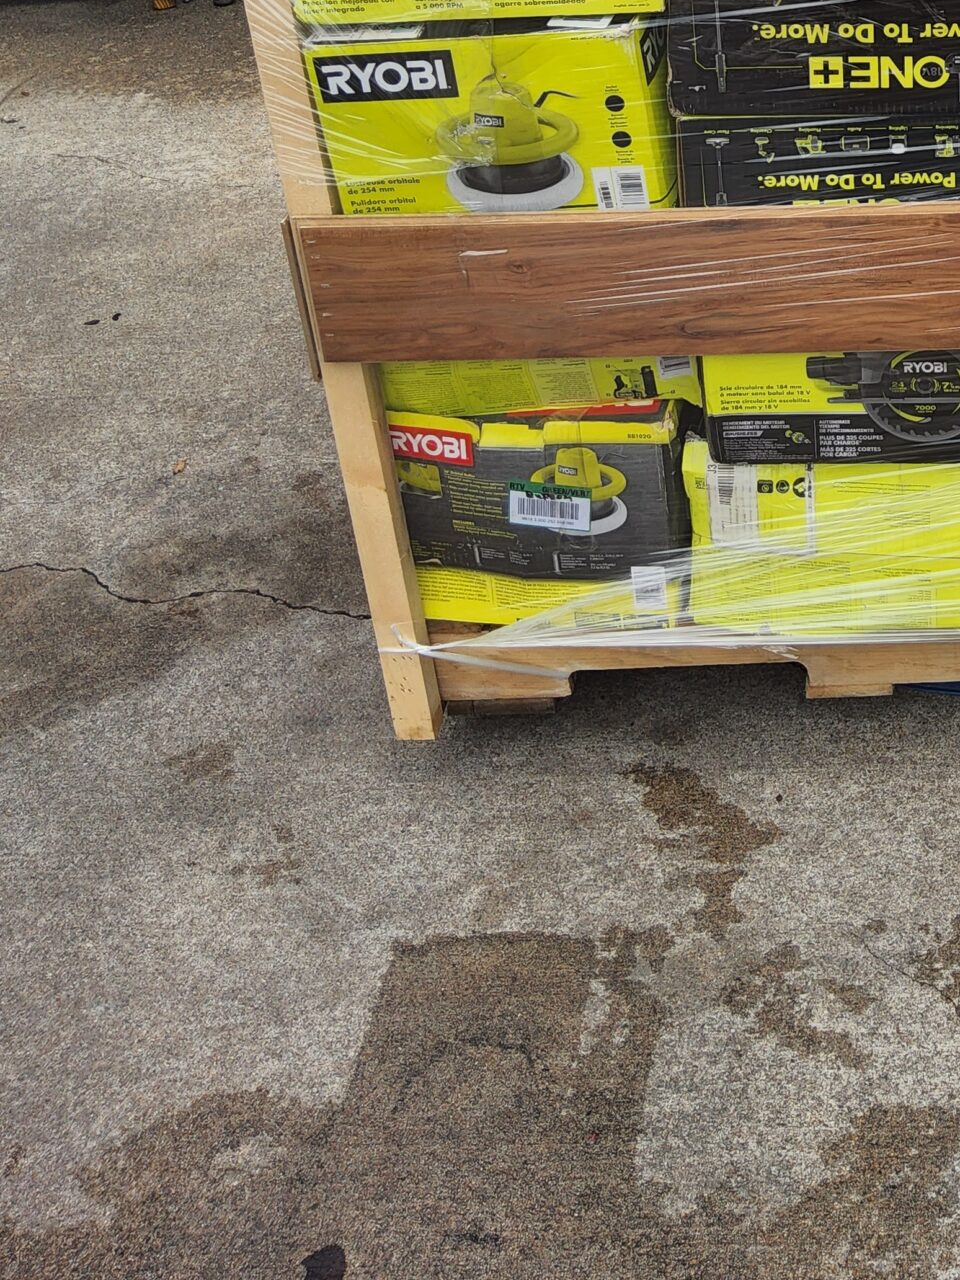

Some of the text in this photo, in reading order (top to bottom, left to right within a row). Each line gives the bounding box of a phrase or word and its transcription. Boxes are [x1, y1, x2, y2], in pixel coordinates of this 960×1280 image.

[495, 1, 521, 9] agarre
[752, 23, 830, 45] More.
[838, 23, 875, 44] Do
[883, 23, 914, 44] To
[321, 59, 450, 95] RYOBI
[808, 56, 951, 90] ONE+
[387, 176, 420, 185] orbitale
[757, 174, 818, 191] More.
[825, 174, 856, 190] Do
[862, 173, 885, 189] To
[891, 173, 956, 189] Power
[360, 186, 377, 194] 254
[350, 196, 416, 207] Pulidora orbital
[366, 206, 382, 214] 254
[902, 361, 948, 375] RYOBI
[389, 430, 470, 461] RYOBI
[510, 481, 525, 491] RTV
